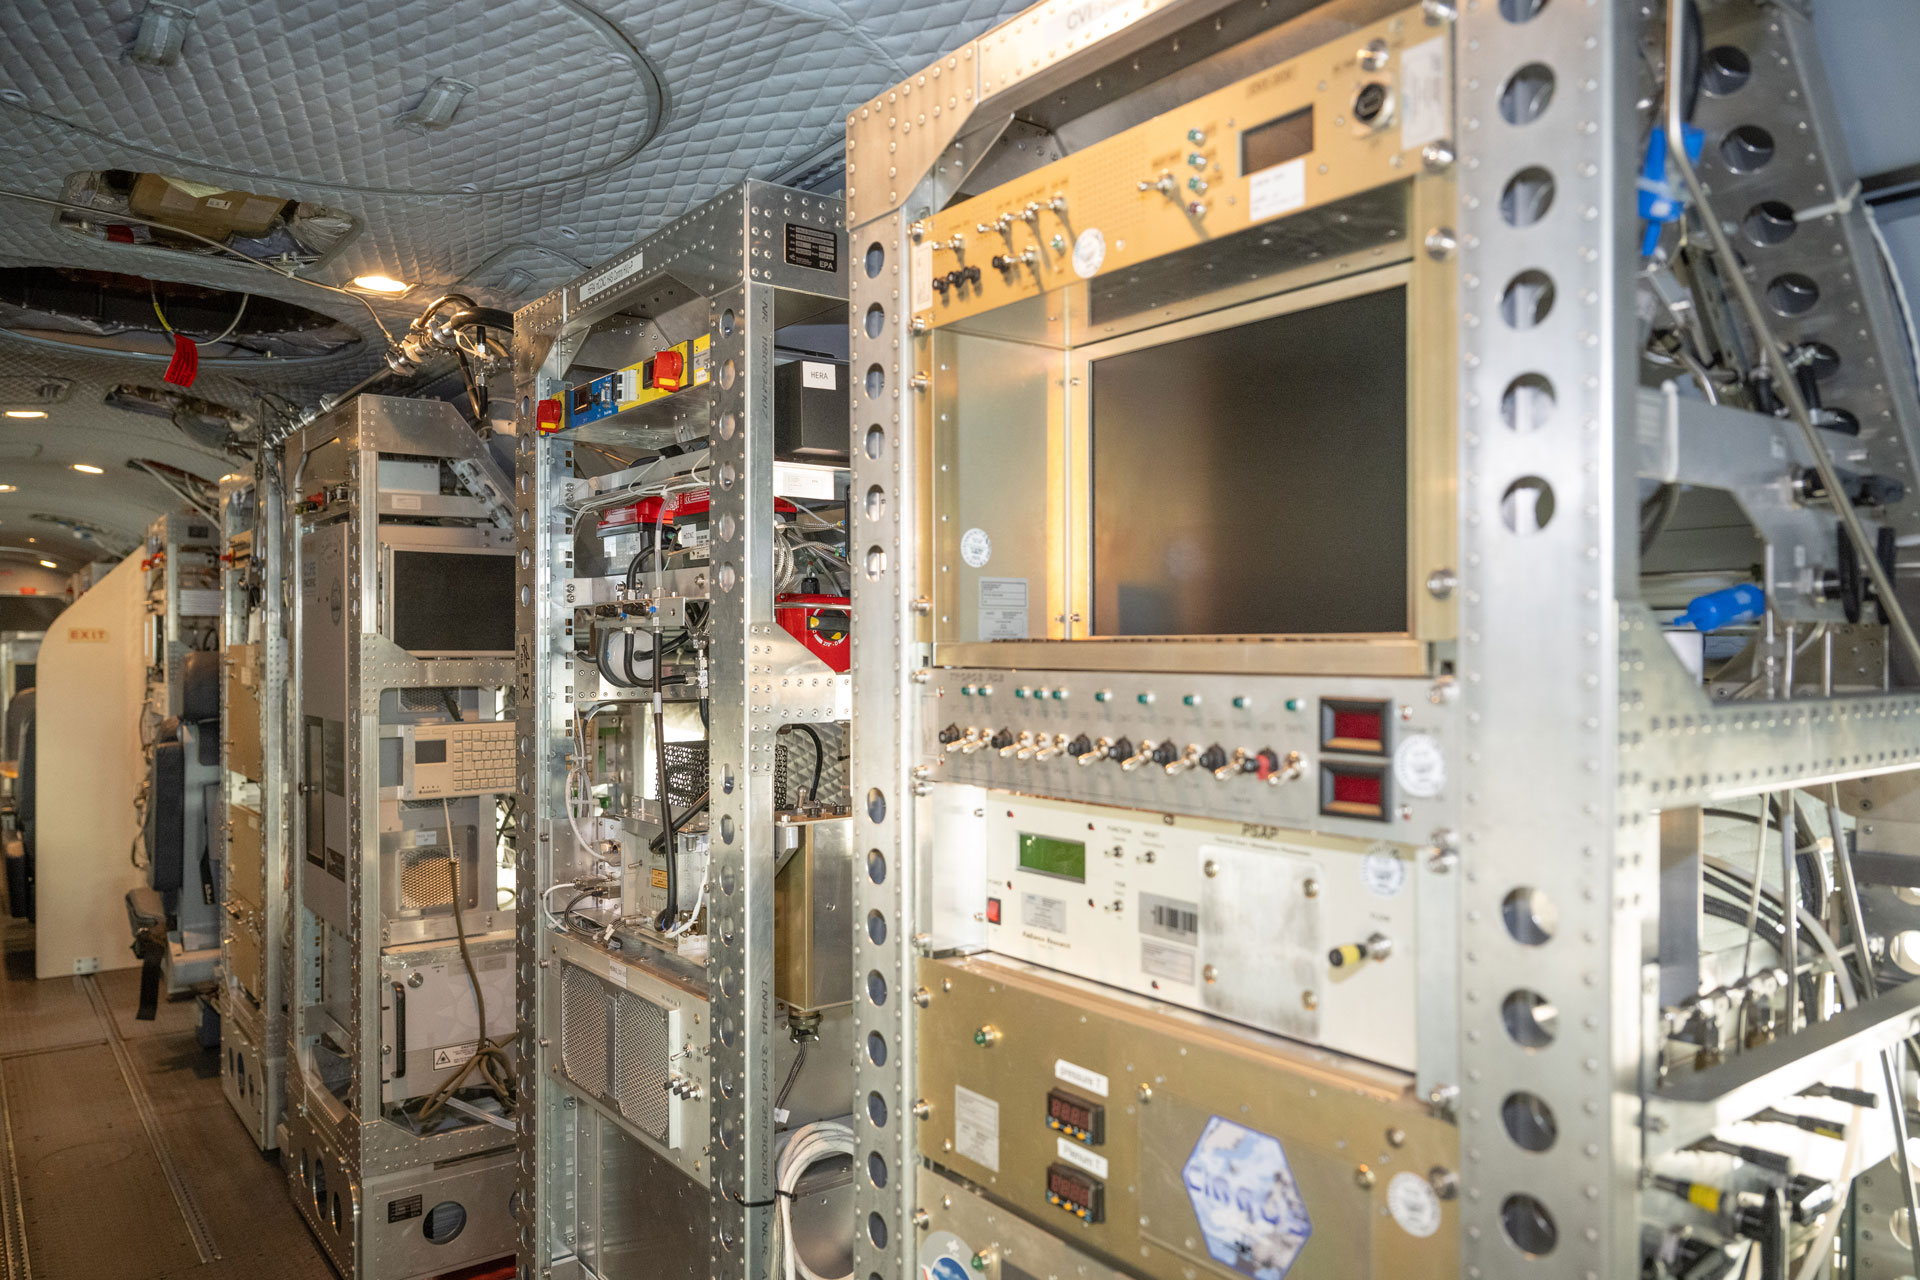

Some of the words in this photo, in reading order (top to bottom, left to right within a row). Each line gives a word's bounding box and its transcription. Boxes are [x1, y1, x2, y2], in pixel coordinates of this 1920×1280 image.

[819, 260, 834, 270] EPA
[810, 371, 829, 380] HERA
[70, 630, 105, 641] EXIT
